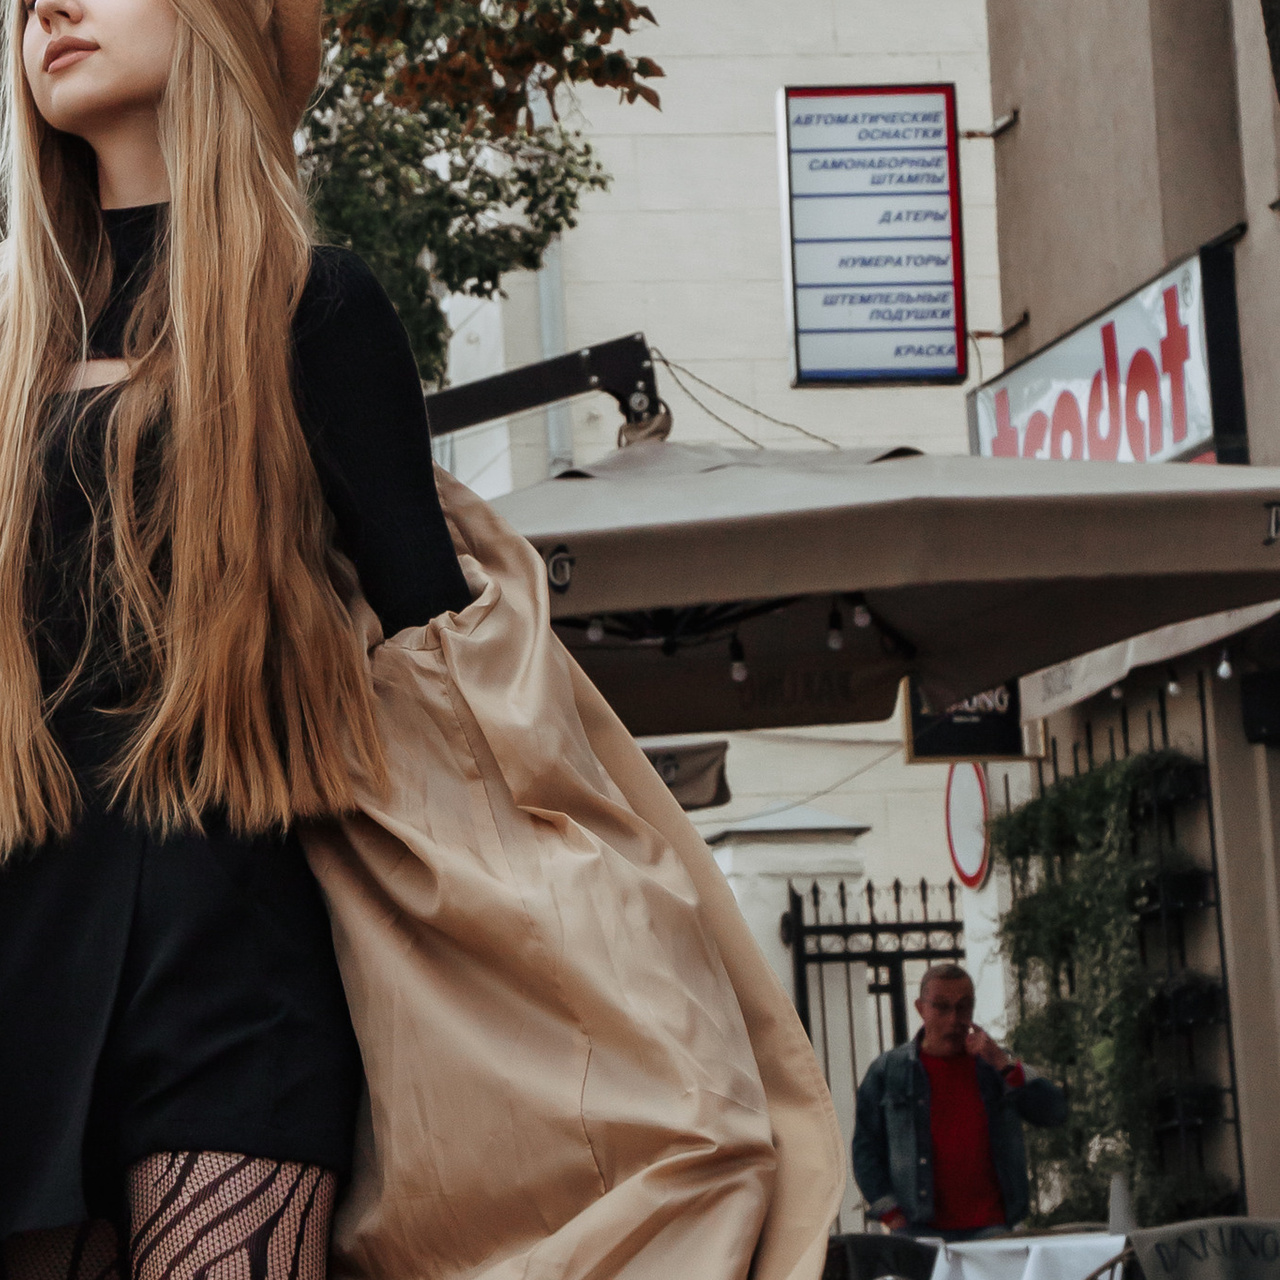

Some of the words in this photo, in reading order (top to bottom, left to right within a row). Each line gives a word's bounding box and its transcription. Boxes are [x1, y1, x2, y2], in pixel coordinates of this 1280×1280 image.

[794, 112, 943, 125] АВТОМАТИЧЕСКИЕ
[858, 128, 944, 141] ОСНАСТКИ
[809, 157, 944, 171] САМОНАБОРНЫЕ
[871, 173, 945, 185] ШТАМПЫ
[879, 210, 948, 224] ДАТЕРЫ
[839, 255, 949, 268] НУМЕРАТОРЫ
[823, 292, 950, 306] ШТЕМПЕЛЬНЫЕ
[870, 308, 951, 321] ПОДУШКИ
[894, 344, 956, 357] КРАСКА
